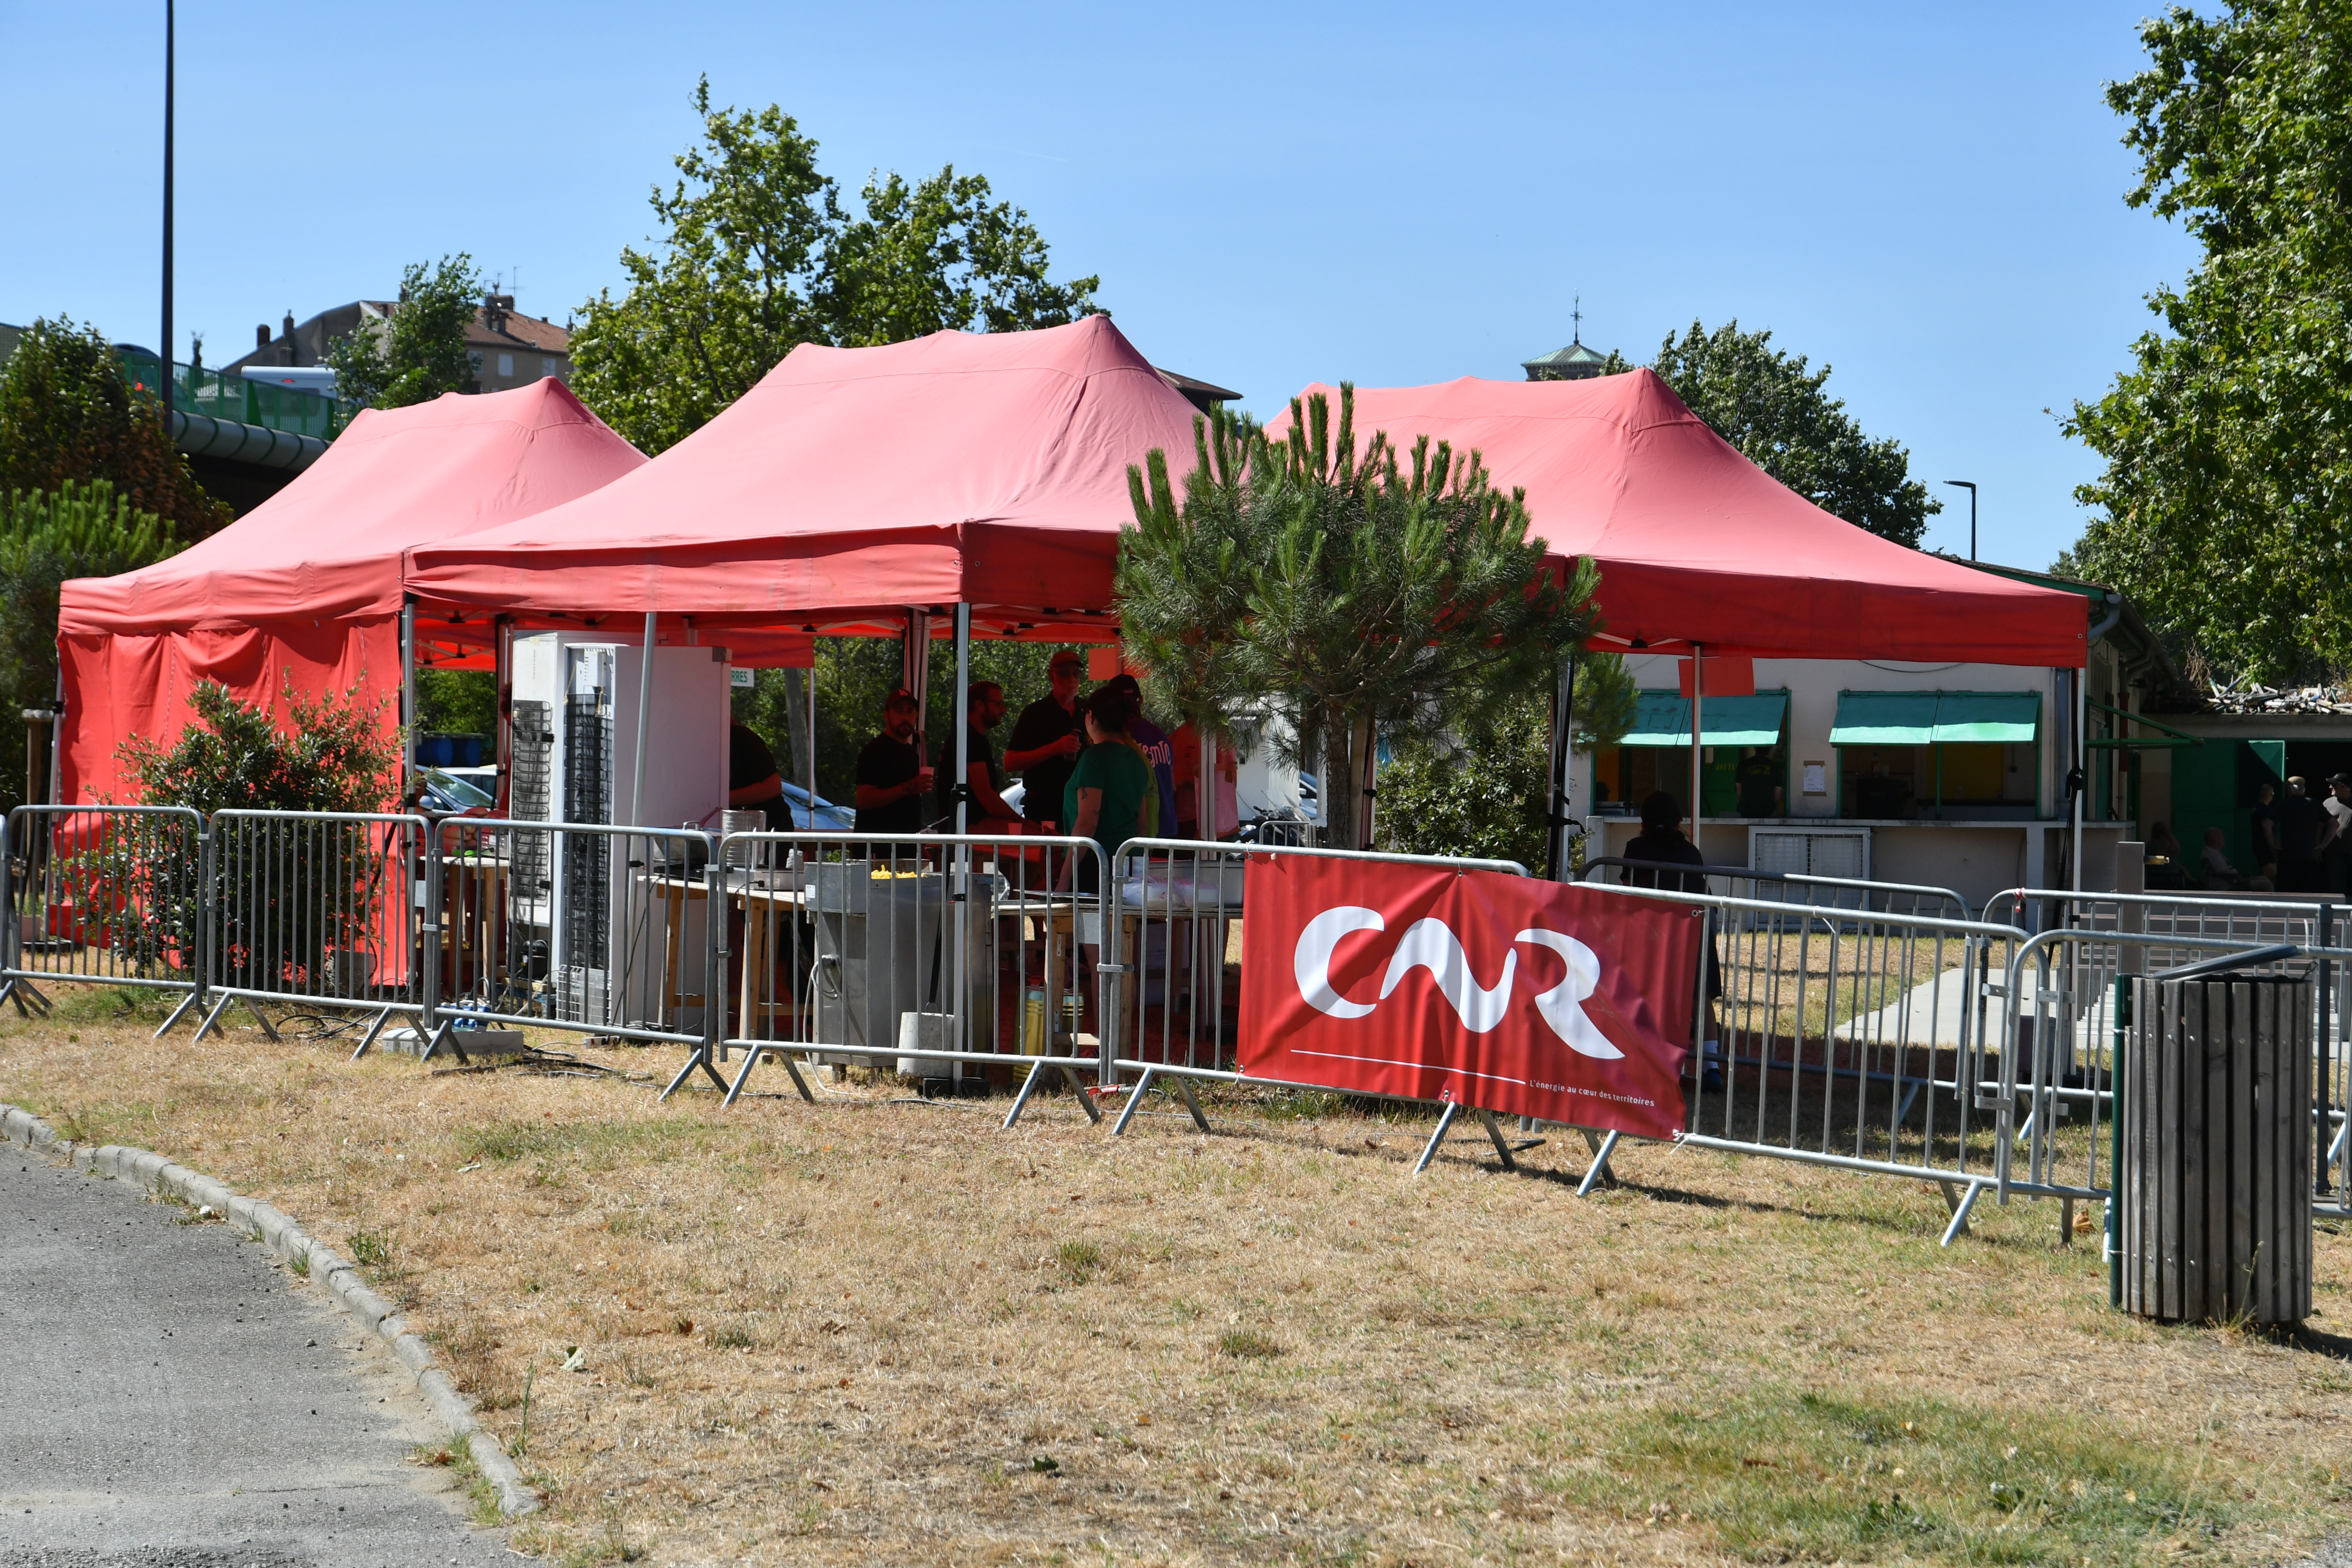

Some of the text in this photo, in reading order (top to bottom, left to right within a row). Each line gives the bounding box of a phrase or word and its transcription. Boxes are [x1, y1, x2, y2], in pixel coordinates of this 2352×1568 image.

[1294, 906, 1625, 1059] CNR
[1530, 1079, 1565, 1092] L'énergie
[1579, 1088, 1597, 1097] cœur
[1599, 1090, 1612, 1099] des
[1613, 1093, 1655, 1106] territoires
